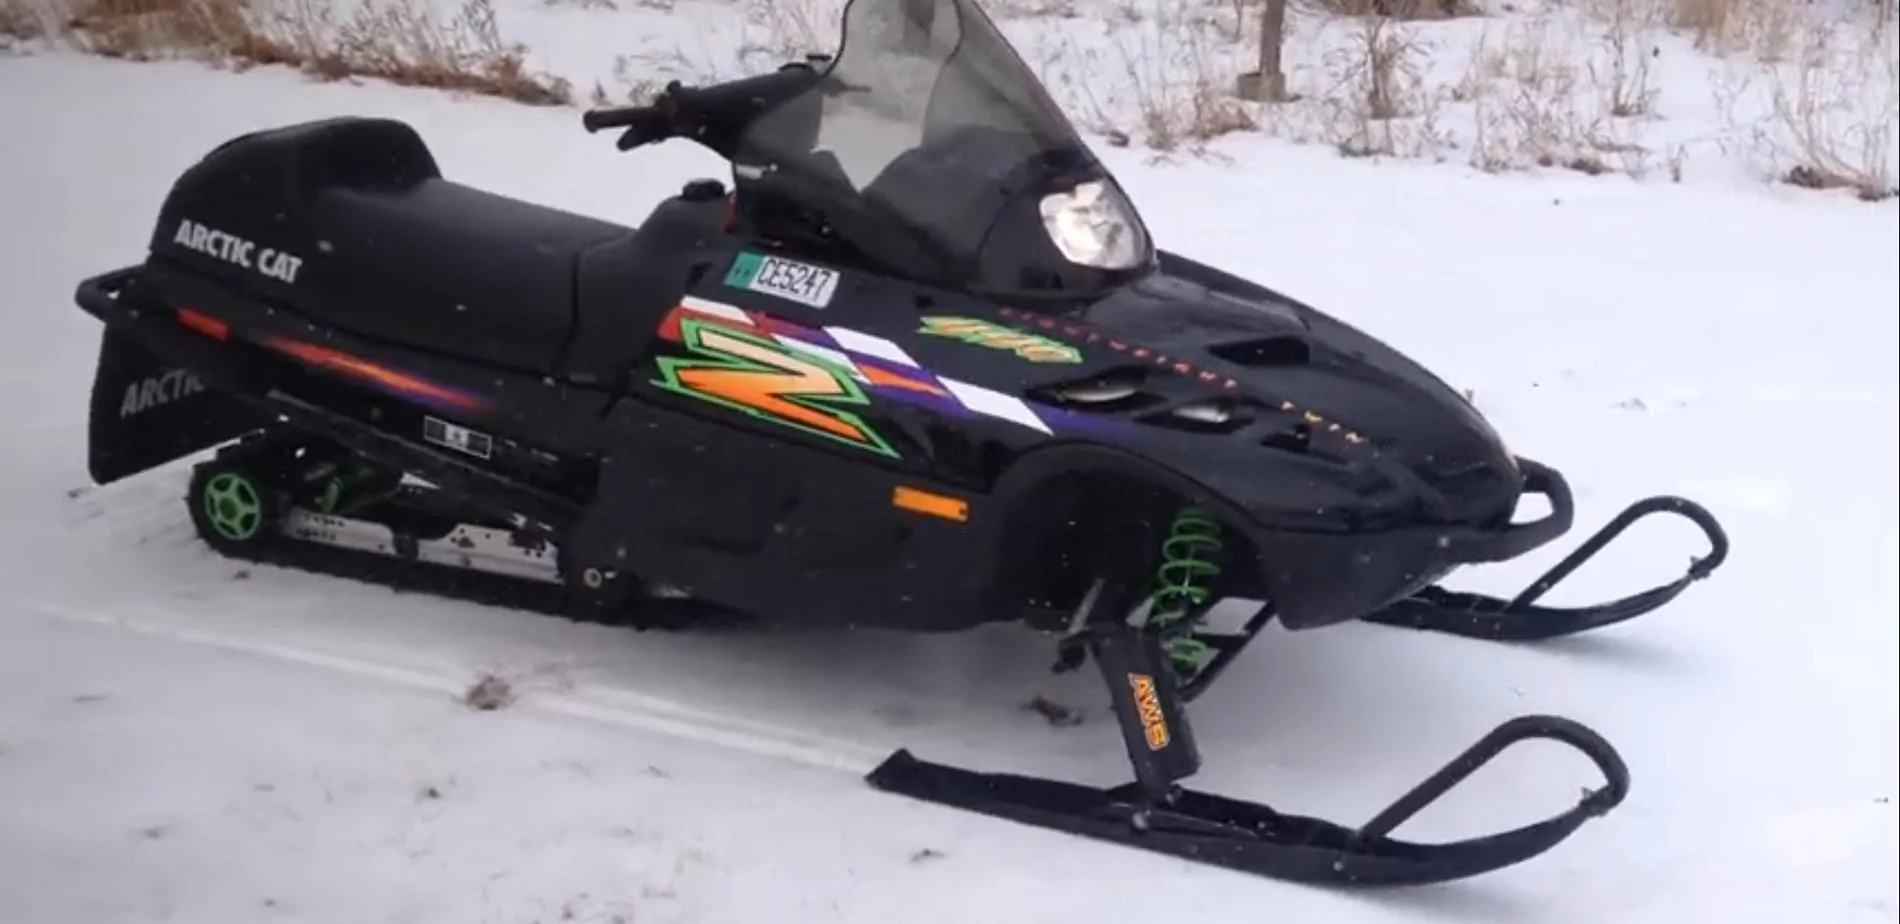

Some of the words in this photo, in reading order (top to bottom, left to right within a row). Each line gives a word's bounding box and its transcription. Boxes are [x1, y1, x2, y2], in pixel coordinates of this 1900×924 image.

[174, 218, 255, 268] ARCTIC
[257, 247, 303, 284] CAT
[757, 257, 832, 300] CE5247
